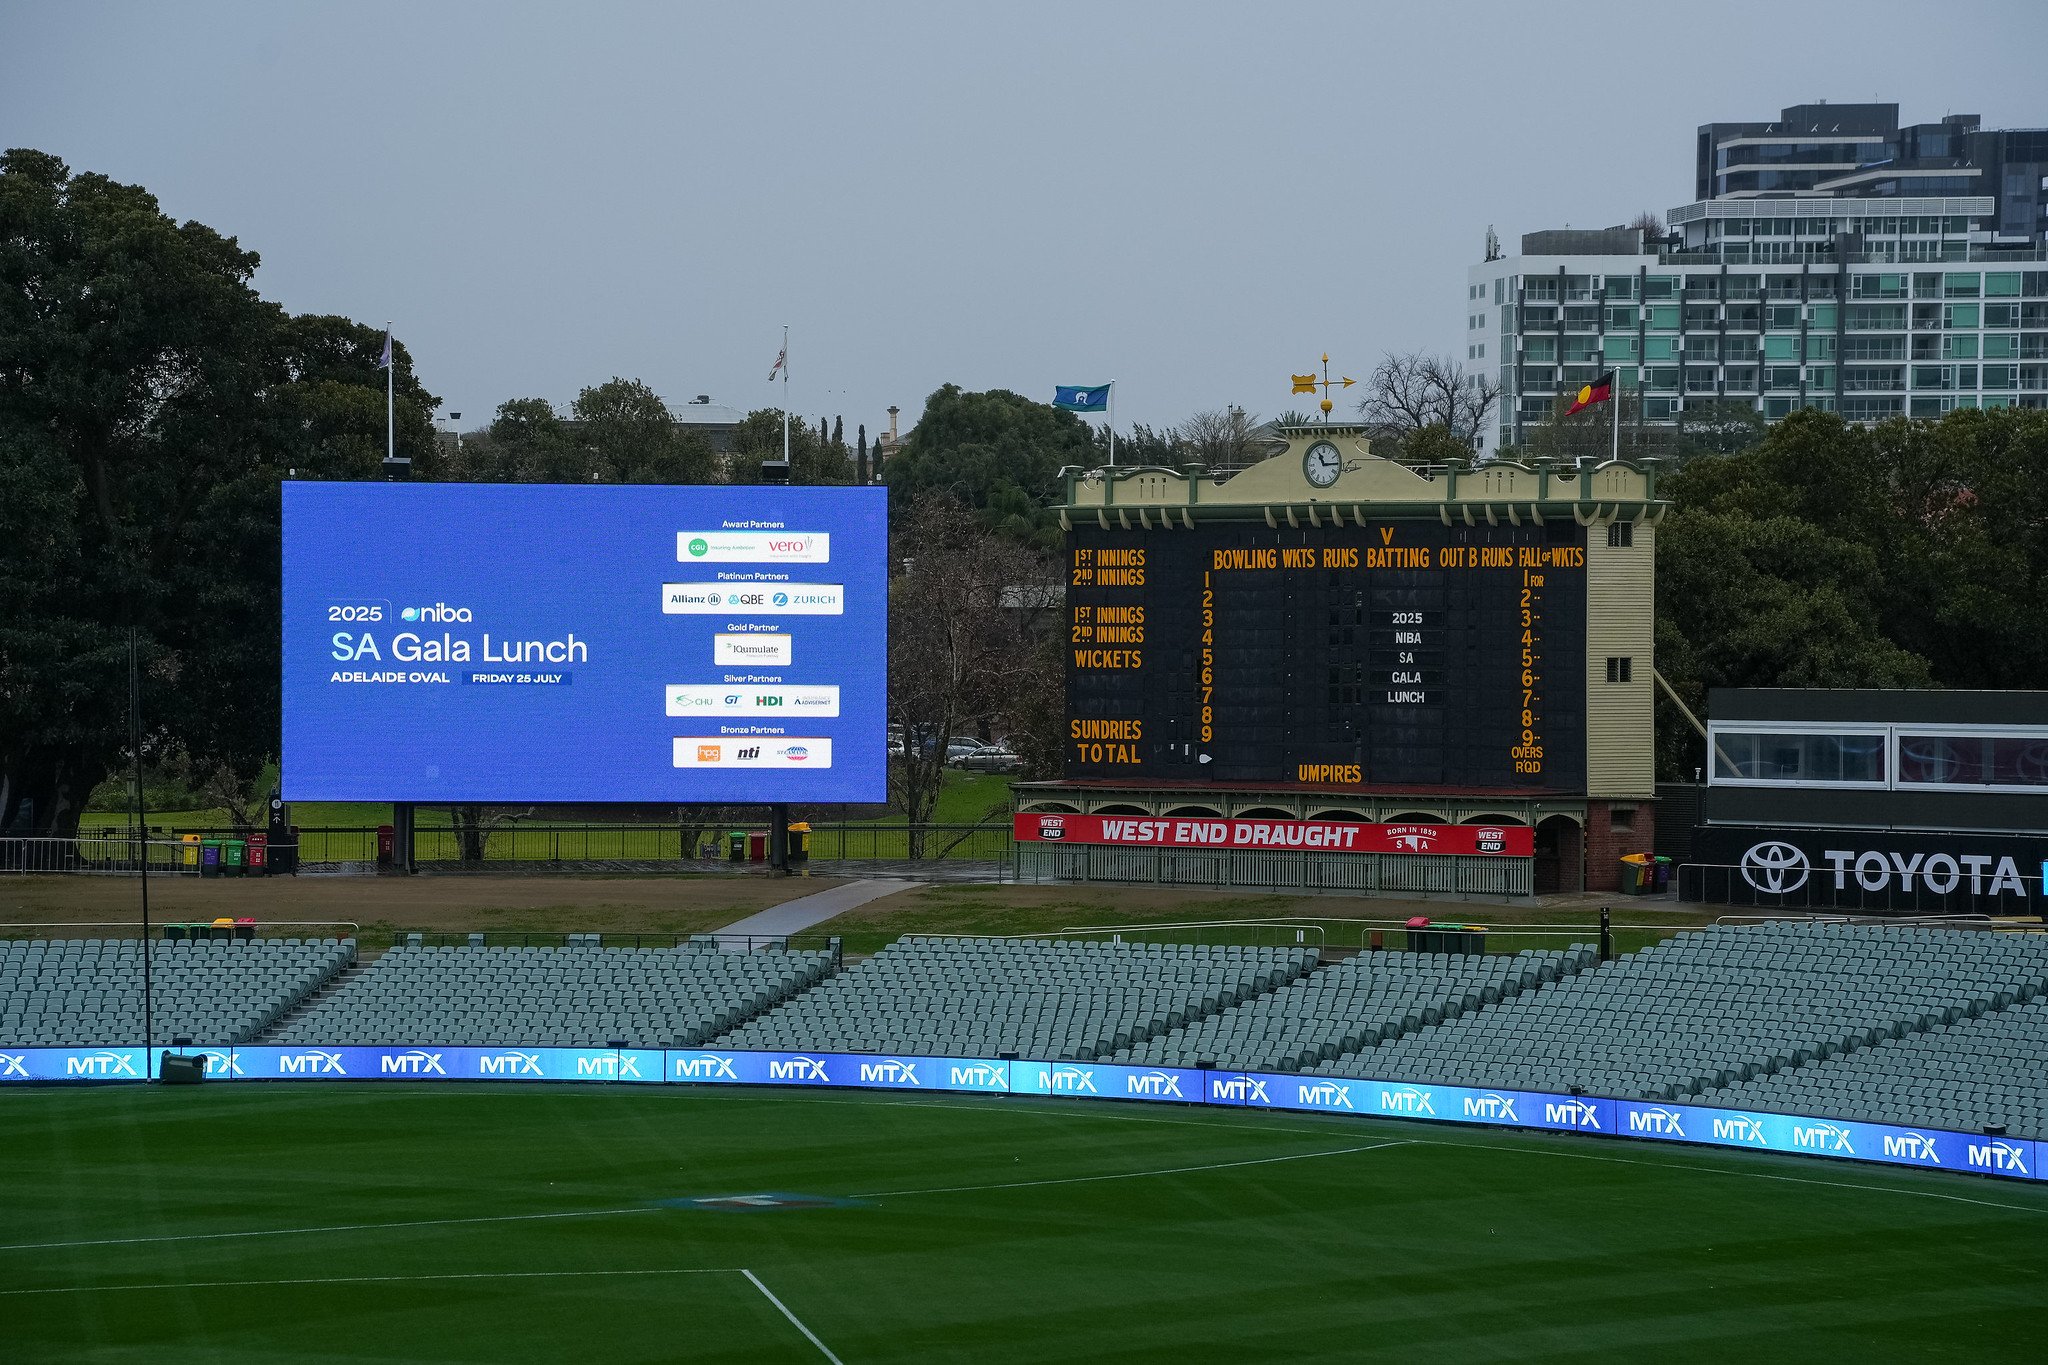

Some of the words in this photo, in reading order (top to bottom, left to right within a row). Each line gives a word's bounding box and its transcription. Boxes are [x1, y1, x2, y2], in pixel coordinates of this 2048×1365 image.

[722, 520, 749, 529] Award
[750, 521, 785, 529] Partners
[1381, 527, 1394, 545] V
[769, 541, 804, 552] vero
[1097, 549, 1145, 566] INNINGS
[1214, 549, 1276, 570] BOWLING
[1282, 549, 1315, 568] WKTS
[1323, 548, 1358, 568] RUNS
[1367, 548, 1430, 568] BATTING
[1439, 547, 1465, 567] OUT
[1468, 547, 1478, 567] B
[1481, 547, 1514, 567] RUNS
[1518, 547, 1542, 567] FALL
[1542, 552, 1551, 562] OF
[1552, 547, 1584, 567] WKTS
[717, 572, 754, 580] Platinum
[755, 572, 789, 580] Partners
[1073, 569, 1092, 586] 2ND
[1097, 569, 1145, 586] INNINGS
[1205, 572, 1209, 588] 1
[1524, 570, 1529, 587] 1
[1531, 575, 1544, 587] FOR
[671, 594, 705, 604] Allianz
[740, 594, 764, 605] QBE
[793, 595, 836, 604] ZURICH
[1202, 590, 1213, 607] 2
[1521, 589, 1531, 607] 2
[328, 606, 383, 622] 2025
[420, 602, 473, 623] niba
[1096, 607, 1145, 624] INNINGS
[1203, 610, 1213, 627] 3
[1392, 612, 1423, 624] 2025
[1521, 609, 1531, 627] 3
[727, 623, 747, 631] Gold
[1072, 626, 1092, 643] 2ND
[1096, 626, 1144, 643] INNINGS
[1202, 629, 1213, 645] 4
[1395, 632, 1422, 644] NIBA
[1521, 629, 1532, 647] 4
[331, 632, 382, 661] SA
[392, 633, 471, 662] Gala
[483, 633, 588, 663] Lunch
[733, 645, 779, 653] IQumulate
[1075, 650, 1142, 668] WICKETS
[1203, 649, 1213, 666] 5
[1399, 652, 1414, 664] SA
[1522, 649, 1532, 667] 5
[330, 672, 406, 683] ADELAIDE
[409, 672, 450, 684] OVAL
[472, 674, 514, 683] FRIDAY
[516, 674, 531, 684] 25
[532, 674, 562, 684] JULY
[723, 675, 747, 683] Silver
[748, 675, 782, 683] Partners
[1202, 668, 1213, 685] 6
[1392, 672, 1422, 684] GALA
[1521, 669, 1532, 687] 6
[695, 698, 713, 706] CHU
[725, 695, 742, 704] GT
[756, 696, 782, 706] HDI
[1202, 687, 1213, 704] 7
[1387, 692, 1425, 704] LUNCH
[1523, 690, 1532, 707] 7
[1202, 706, 1213, 724] 8
[1521, 710, 1532, 727] 8
[720, 726, 749, 735] Bronze
[750, 726, 785, 735] Partners
[1071, 719, 1142, 740] SUNDRIES
[1202, 726, 1213, 743] 9
[1522, 729, 1533, 747] 9
[737, 746, 760, 758] nti
[1077, 743, 1141, 764] TOTAL
[1511, 746, 1543, 758] OVERS
[1299, 765, 1361, 783] UMPIRES
[1041, 819, 1064, 827] WEST
[1387, 827, 1407, 836] BORN
[1420, 828, 1437, 836] 1859
[1043, 829, 1061, 837] END
[1102, 820, 1169, 841] WEST
[1175, 822, 1228, 843] END
[1234, 824, 1359, 847] DRAUGHT
[1478, 831, 1503, 840] WEST
[1481, 842, 1501, 850] END
[1824, 850, 2027, 897] TOYOTA
[67, 1051, 137, 1076] MTX
[280, 1050, 346, 1075] MTX
[381, 1050, 447, 1075] MTX
[480, 1051, 544, 1076] MTX
[577, 1053, 641, 1078] MTX
[676, 1054, 737, 1080] MTX
[770, 1057, 830, 1082] MTX
[861, 1060, 920, 1085] MTX
[951, 1063, 1009, 1089] MTX
[1039, 1067, 1098, 1093] MTX
[1127, 1071, 1183, 1098] MTX
[1213, 1076, 1271, 1103] MTX
[1299, 1082, 1353, 1109] MTX
[1381, 1088, 1436, 1115] MTX
[1464, 1093, 1519, 1122] MTX
[1546, 1100, 1601, 1129] MTX
[1630, 1108, 1686, 1137] MTX
[1713, 1116, 1768, 1145] MTX
[1794, 1123, 1856, 1154] MTX
[1884, 1132, 1941, 1163] MTX
[1969, 1142, 2029, 1174] MTX
